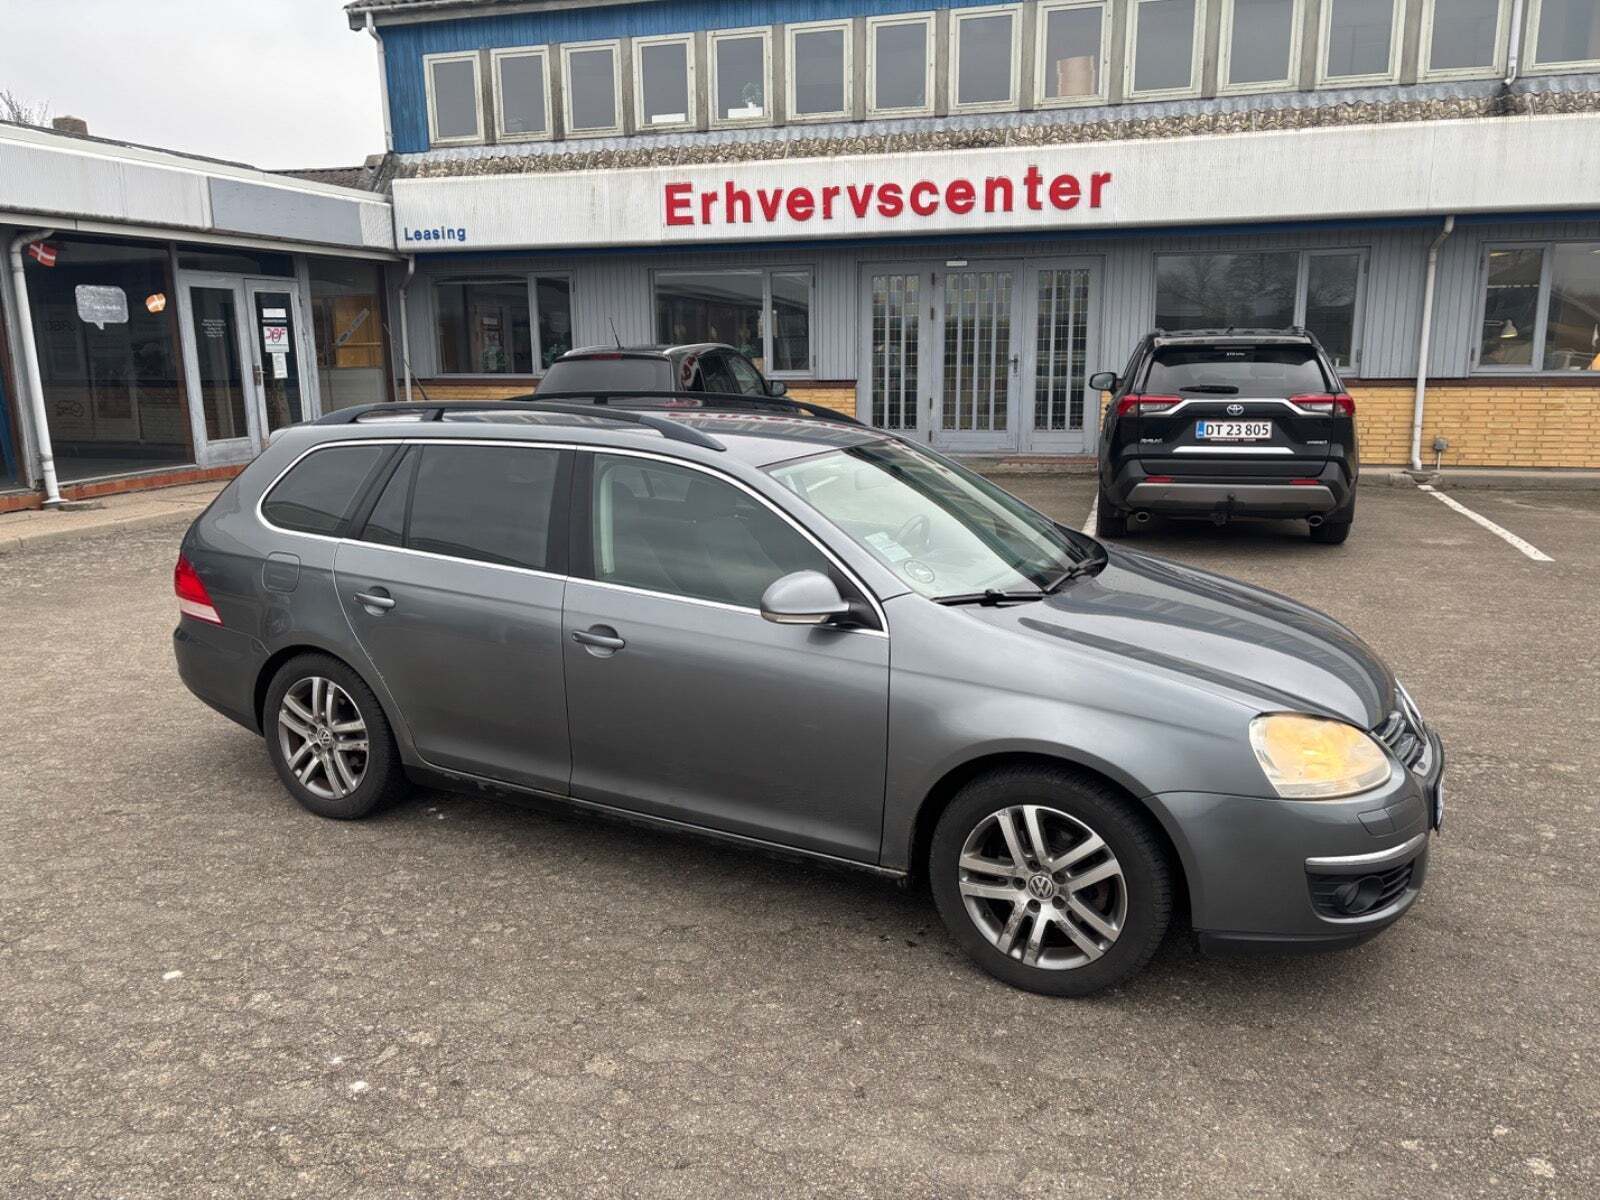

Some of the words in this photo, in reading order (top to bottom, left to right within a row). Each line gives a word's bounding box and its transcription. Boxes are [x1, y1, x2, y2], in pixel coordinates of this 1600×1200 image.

[664, 165, 1112, 225] Erhvervscenter
[404, 225, 466, 242] Leasing
[1206, 424, 1224, 436] DT
[1226, 424, 1242, 436] 23
[1245, 424, 1269, 436] 805
